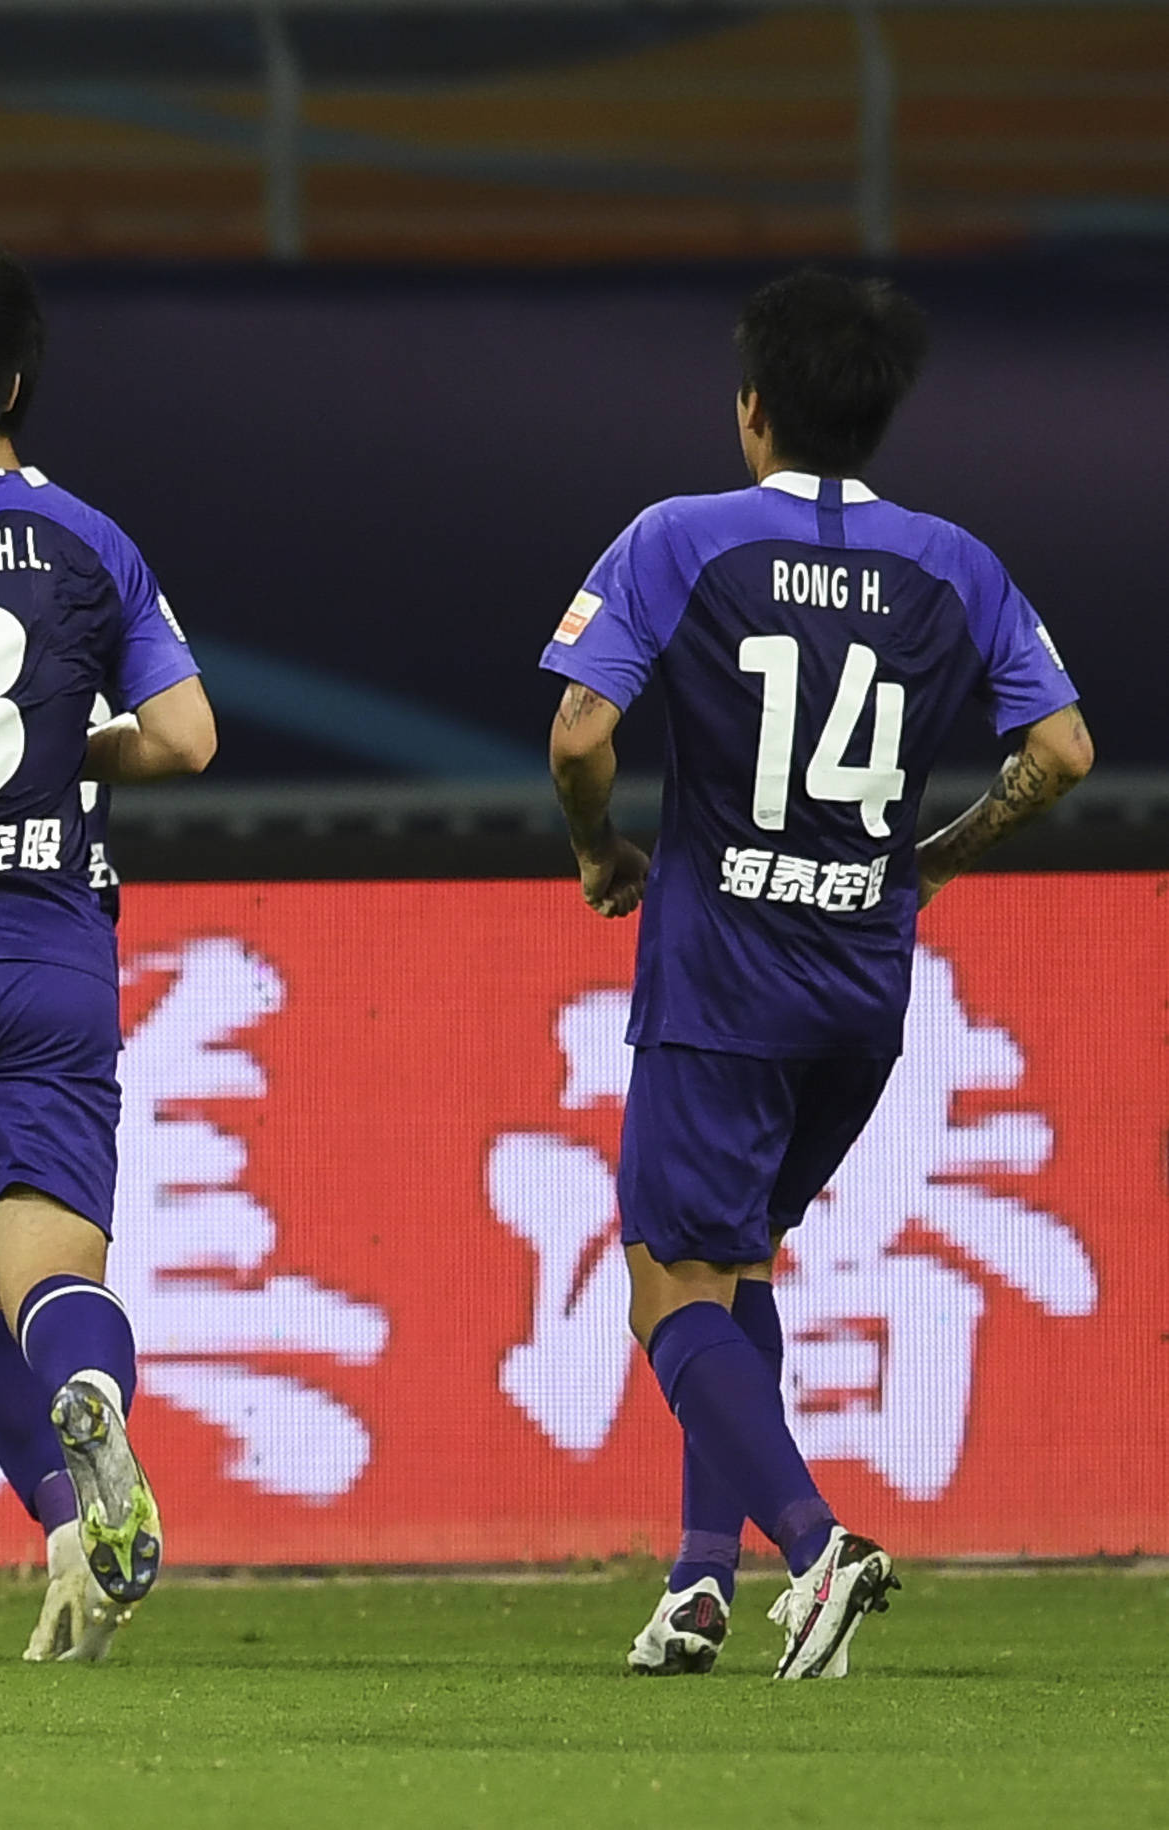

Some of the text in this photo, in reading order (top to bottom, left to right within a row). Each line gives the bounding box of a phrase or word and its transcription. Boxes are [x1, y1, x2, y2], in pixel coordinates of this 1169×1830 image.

[772, 559, 890, 615] RONG H.
[738, 634, 906, 838] 14
